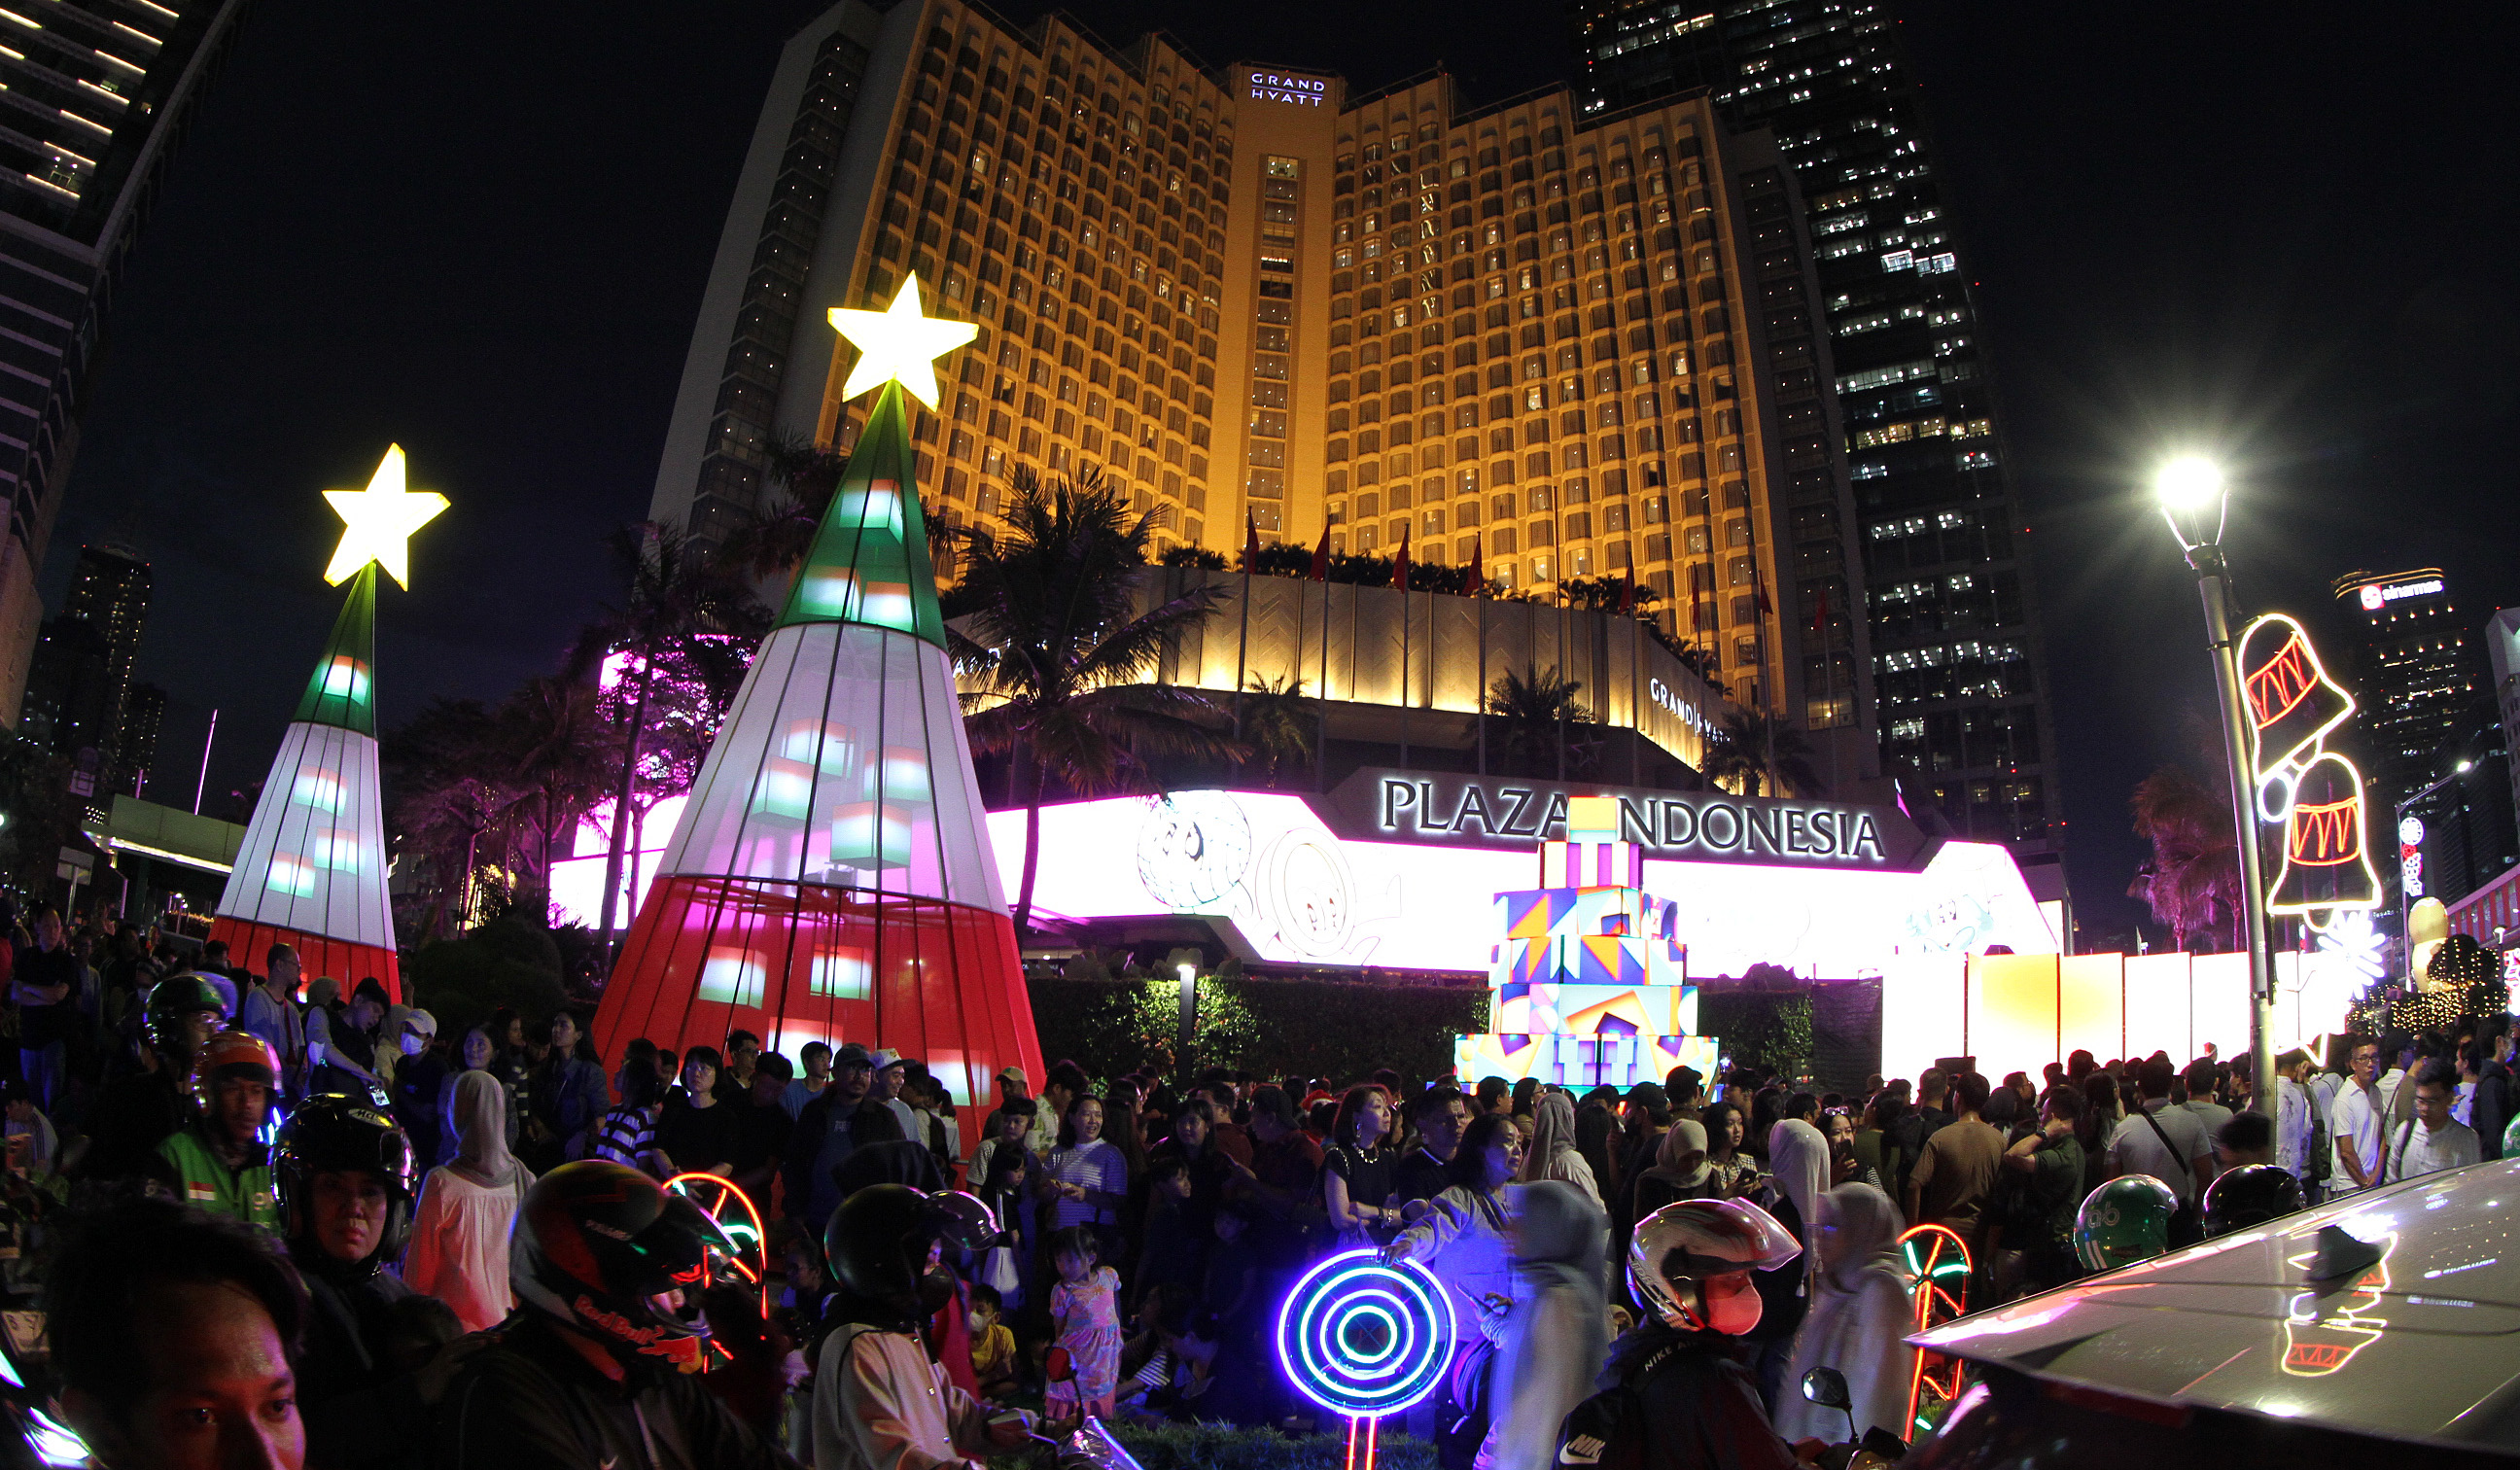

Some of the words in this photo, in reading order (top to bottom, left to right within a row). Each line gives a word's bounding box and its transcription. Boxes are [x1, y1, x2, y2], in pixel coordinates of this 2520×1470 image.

[1250, 73, 1325, 91] GRAND
[1251, 88, 1322, 108] HYATT
[2382, 580, 2444, 601] sinarmas
[1650, 678, 1694, 725] GRAND
[1383, 780, 1567, 839] PLAZA
[1616, 796, 1885, 858] NDONESIA
[1644, 1346, 1673, 1373] NIKE
[1568, 1433, 1607, 1458] NIK
